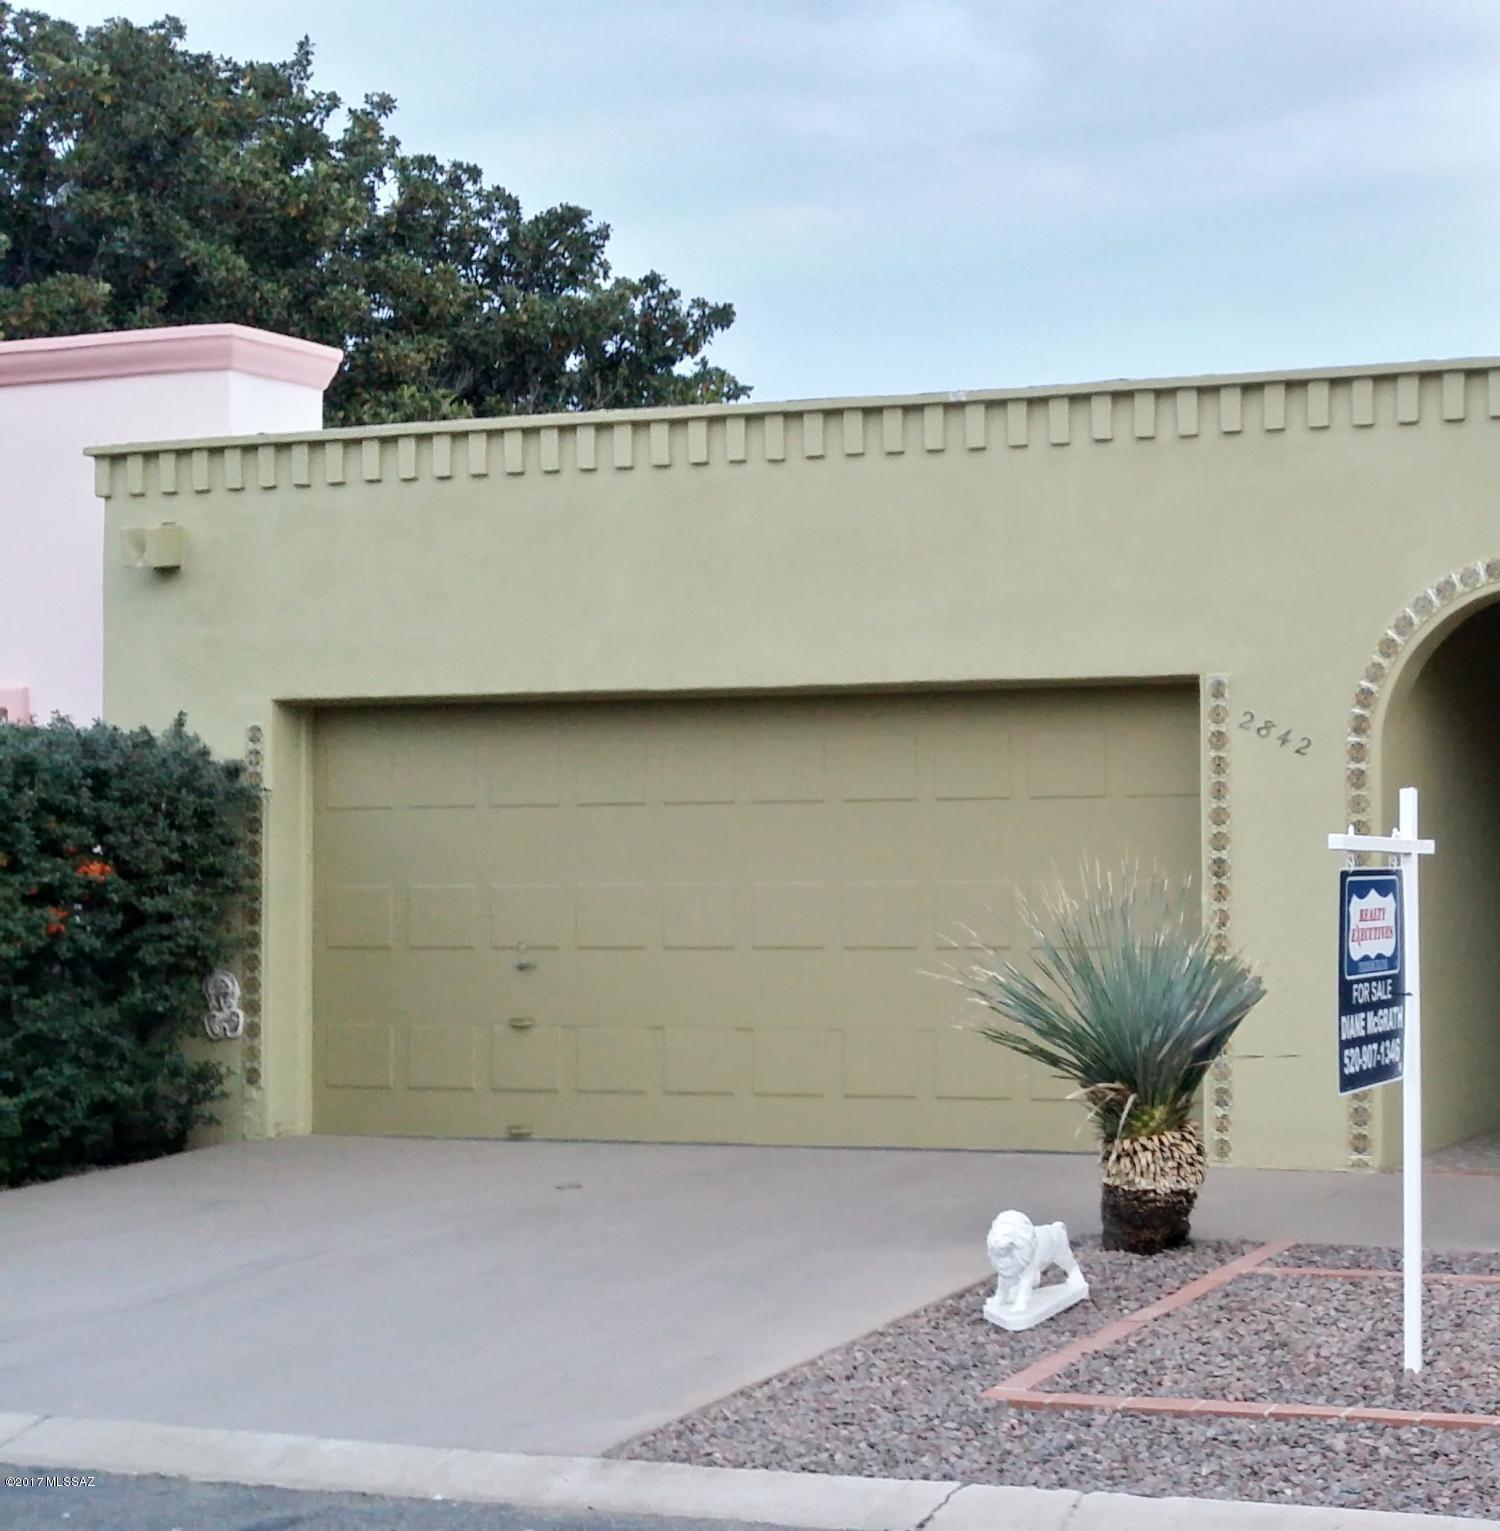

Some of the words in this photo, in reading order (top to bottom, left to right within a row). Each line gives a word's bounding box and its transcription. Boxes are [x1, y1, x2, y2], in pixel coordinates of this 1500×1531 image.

[1238, 710, 1312, 756] 2842
[1359, 907, 1385, 922] REALTY
[1351, 925, 1393, 945] EXECUTIVES
[1352, 982, 1370, 1004] FOR
[1371, 979, 1393, 1001] SALE
[1341, 1012, 1365, 1040] DIANE
